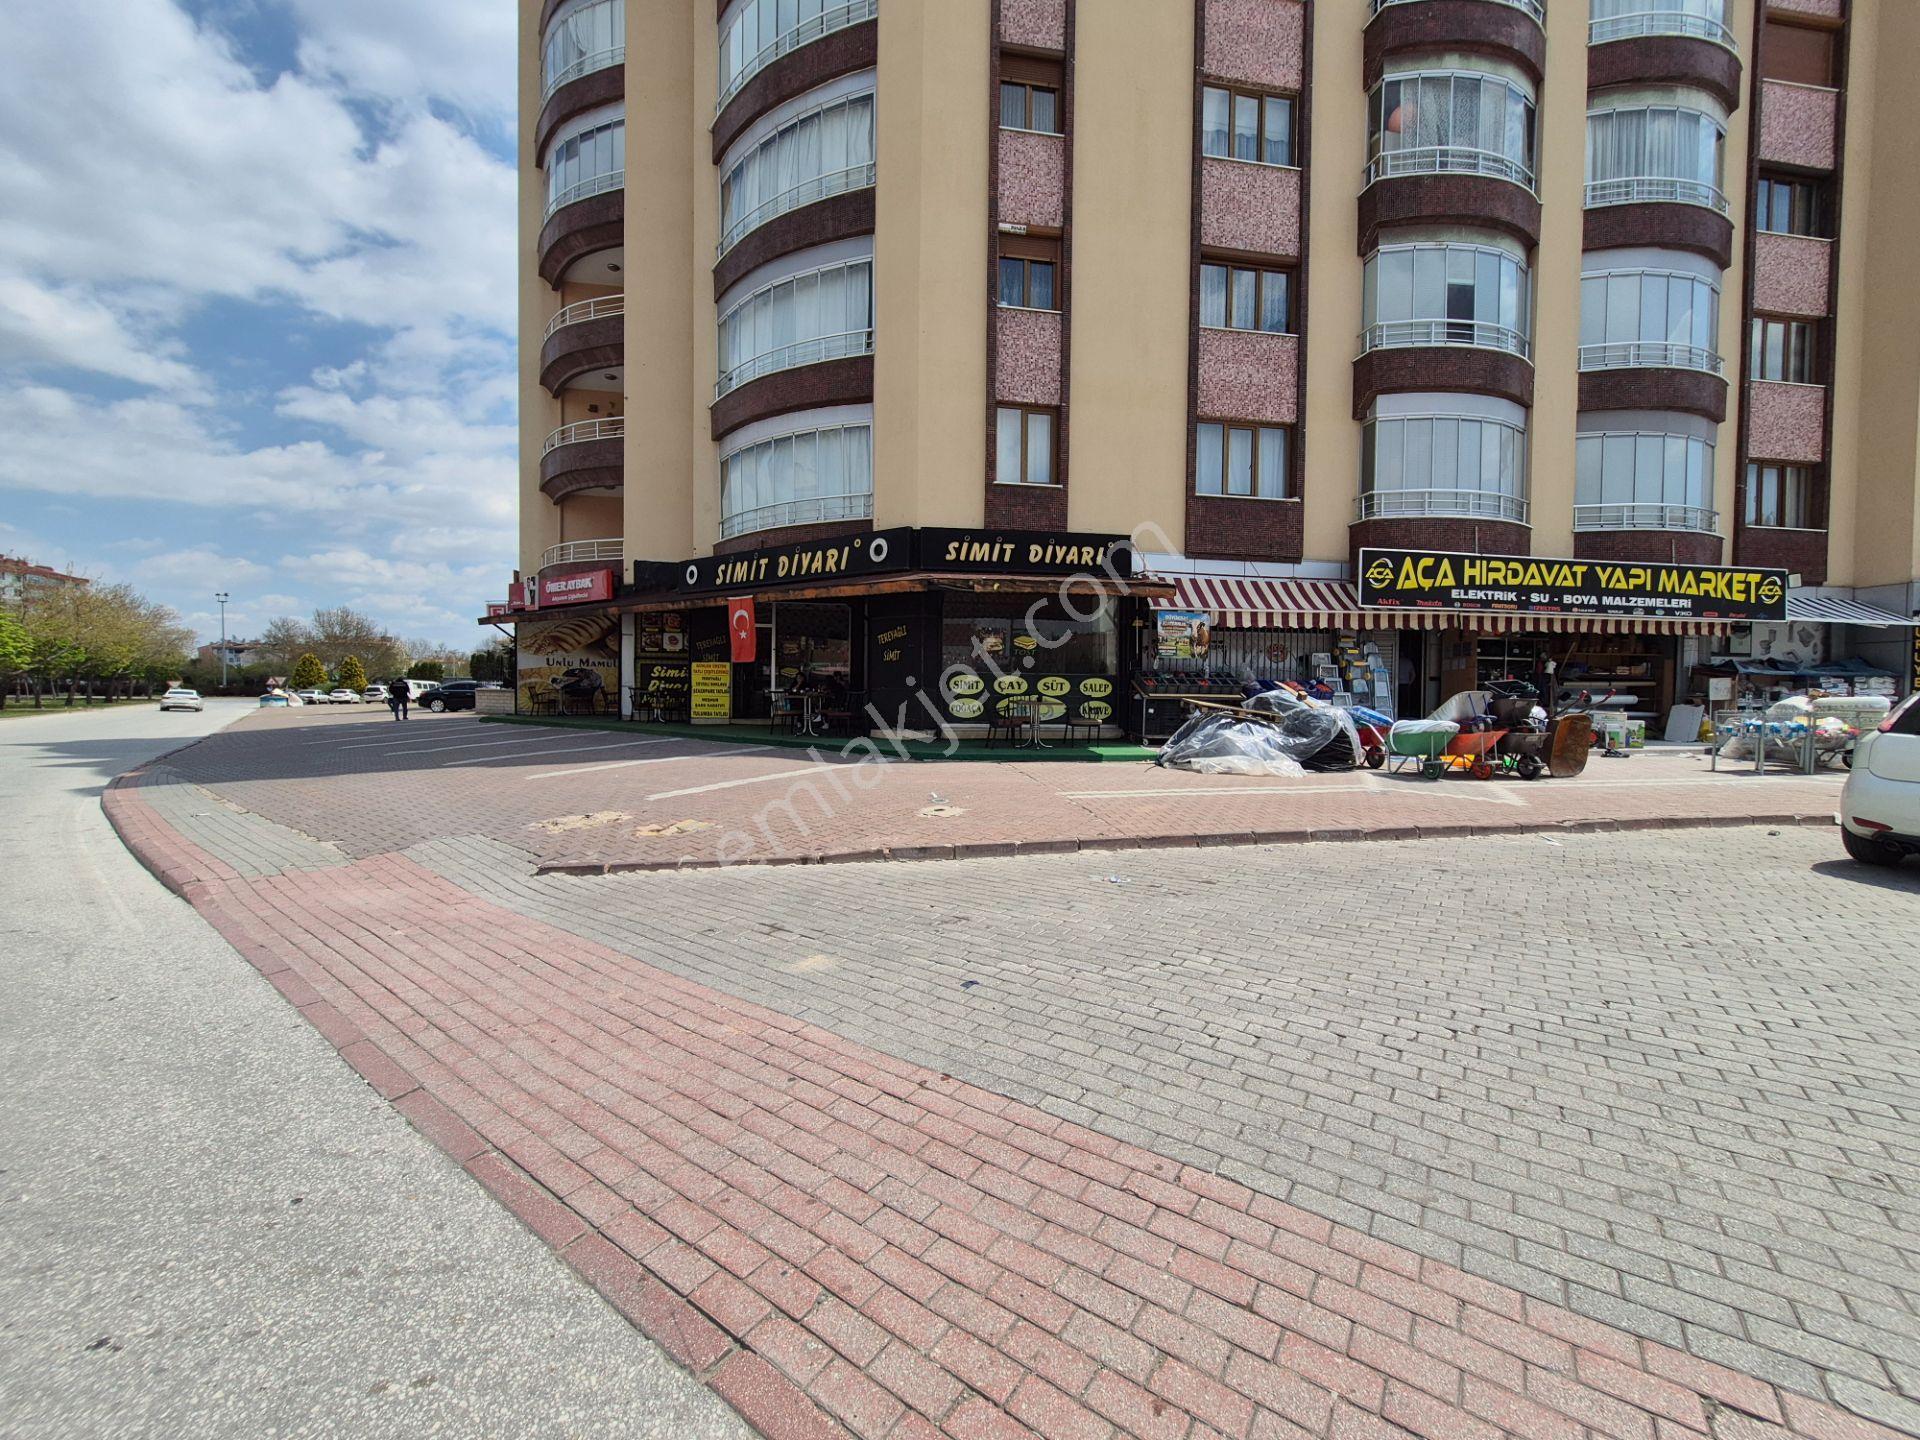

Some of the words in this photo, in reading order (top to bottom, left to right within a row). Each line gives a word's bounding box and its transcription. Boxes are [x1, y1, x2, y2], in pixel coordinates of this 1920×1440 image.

[1396, 556, 1456, 591] AÇA
[1464, 559, 1588, 587] HIRDAVAT
[1594, 566, 1651, 591] YAPI
[1658, 569, 1762, 604] MARKET
[1530, 593, 1550, 603] SU
[1563, 594, 1598, 605] BOYA
[998, 679, 1025, 692] ÇAY
[1043, 680, 1065, 692] SÜT
[1083, 682, 1109, 693] SALEP
